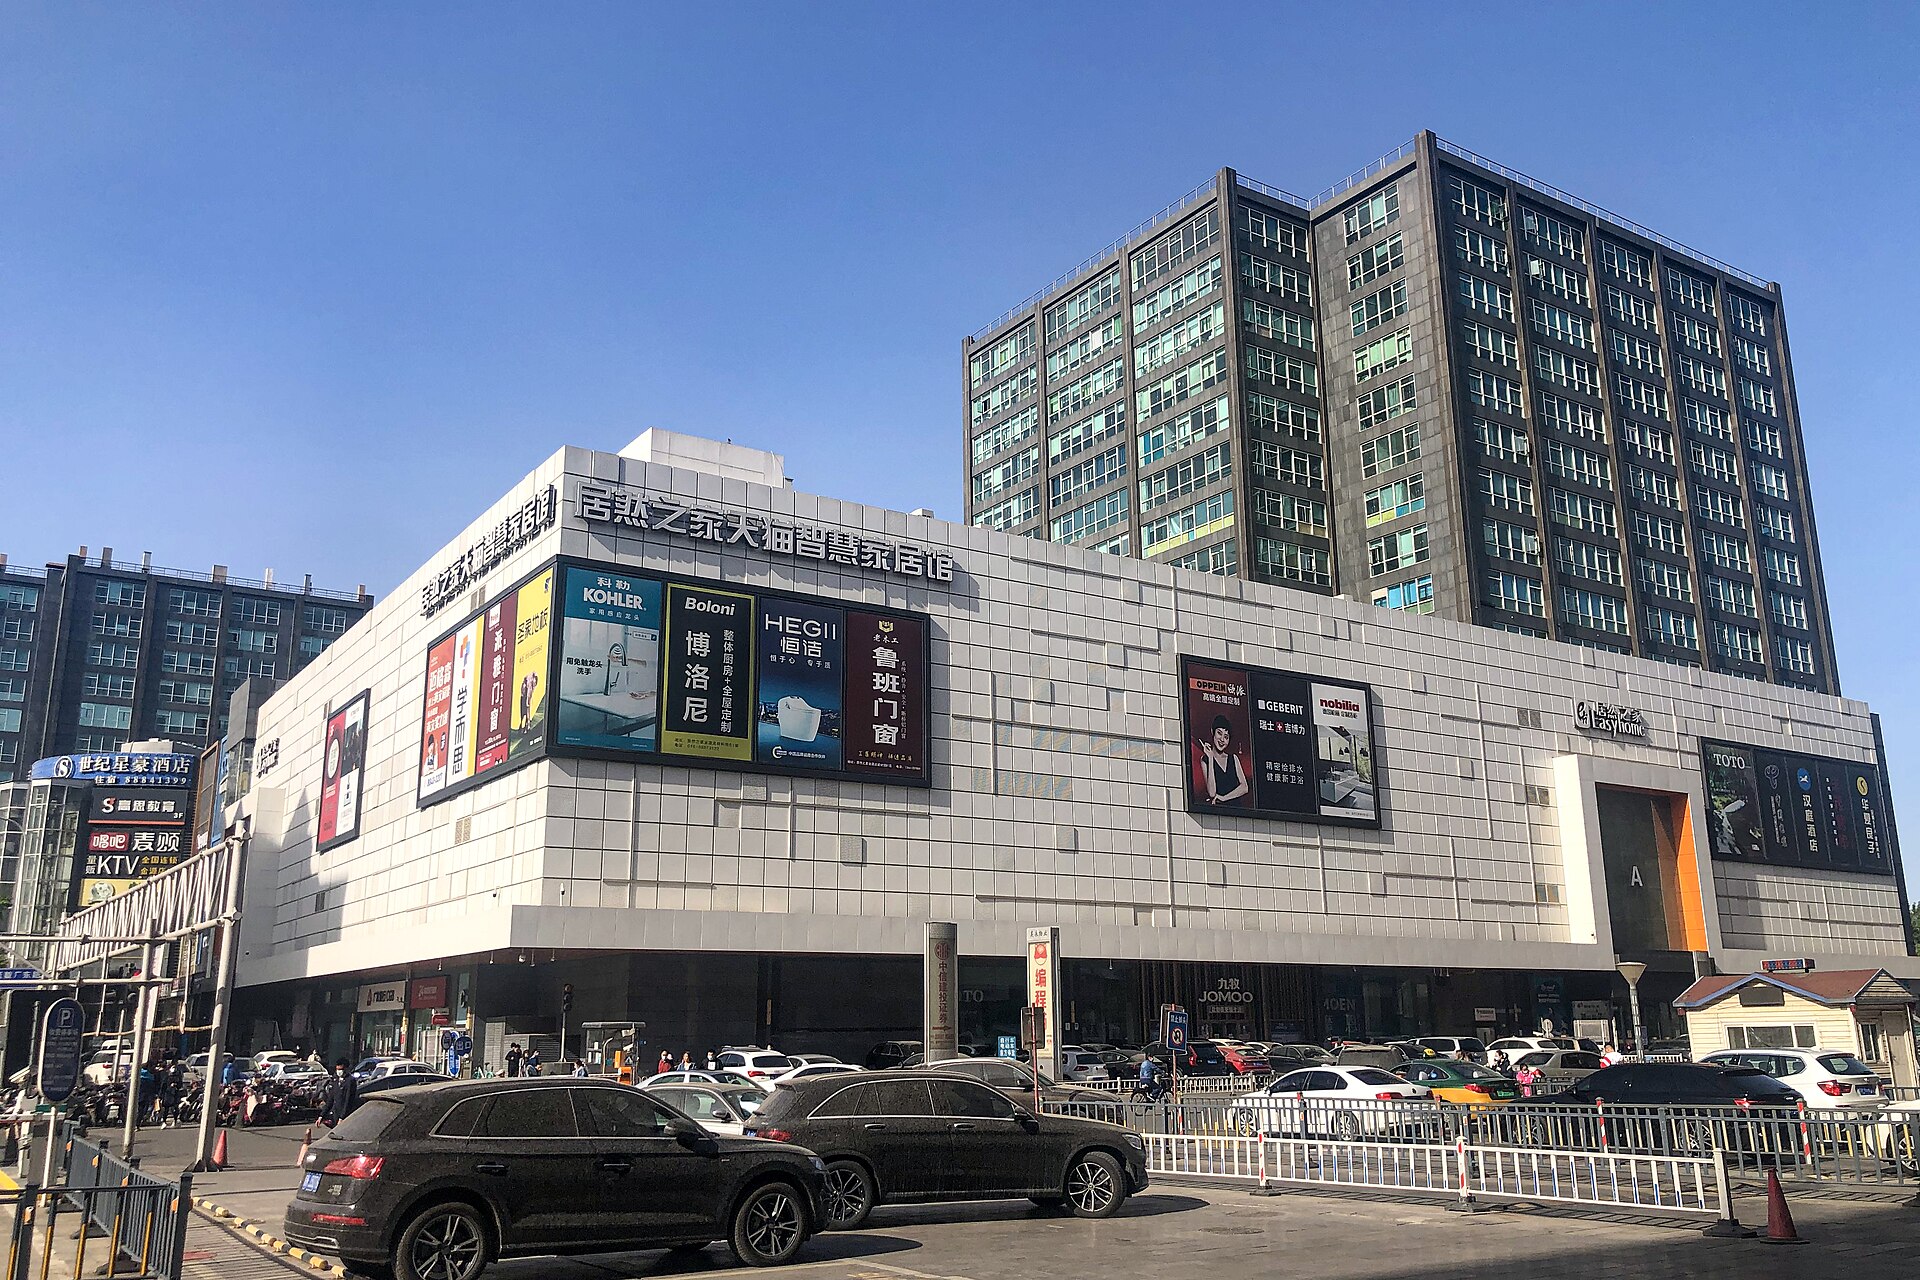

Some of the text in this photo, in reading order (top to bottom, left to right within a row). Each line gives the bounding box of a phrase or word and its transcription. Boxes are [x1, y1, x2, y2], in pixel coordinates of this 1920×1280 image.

[574, 482, 954, 582] 居然之家天猫智慧家居馆
[597, 577, 631, 590] 科勒
[583, 587, 644, 610] KOHLER
[685, 597, 736, 616] Boloni
[765, 613, 836, 641] HEGII
[780, 636, 822, 658] 恒洁
[683, 630, 711, 724] 博洛尼
[720, 629, 736, 734] 整体厨房+全屋定制
[1196, 680, 1226, 692] OPPEIN
[871, 646, 900, 746] 鲁班门窗
[1319, 698, 1360, 712] nobilia
[1266, 700, 1304, 716] GEBERIT
[452, 685, 468, 777] 学而思
[78, 756, 191, 774] 世纪星豪酒店
[1265, 760, 1304, 774] 精密给排水
[1713, 753, 1746, 770] TOTO
[125, 776, 187, 785] 88841399
[1266, 772, 1304, 785] 健康新卫浴
[118, 800, 175, 813] 高思教育
[1802, 794, 1818, 853] 汉庭酒店
[92, 834, 126, 849] 唱吧
[97, 855, 140, 875] KTV
[1630, 865, 1643, 887] A
[938, 960, 948, 1024] 中信建投证券
[962, 989, 984, 1003] TO
[1198, 991, 1254, 1003] JOMOO
